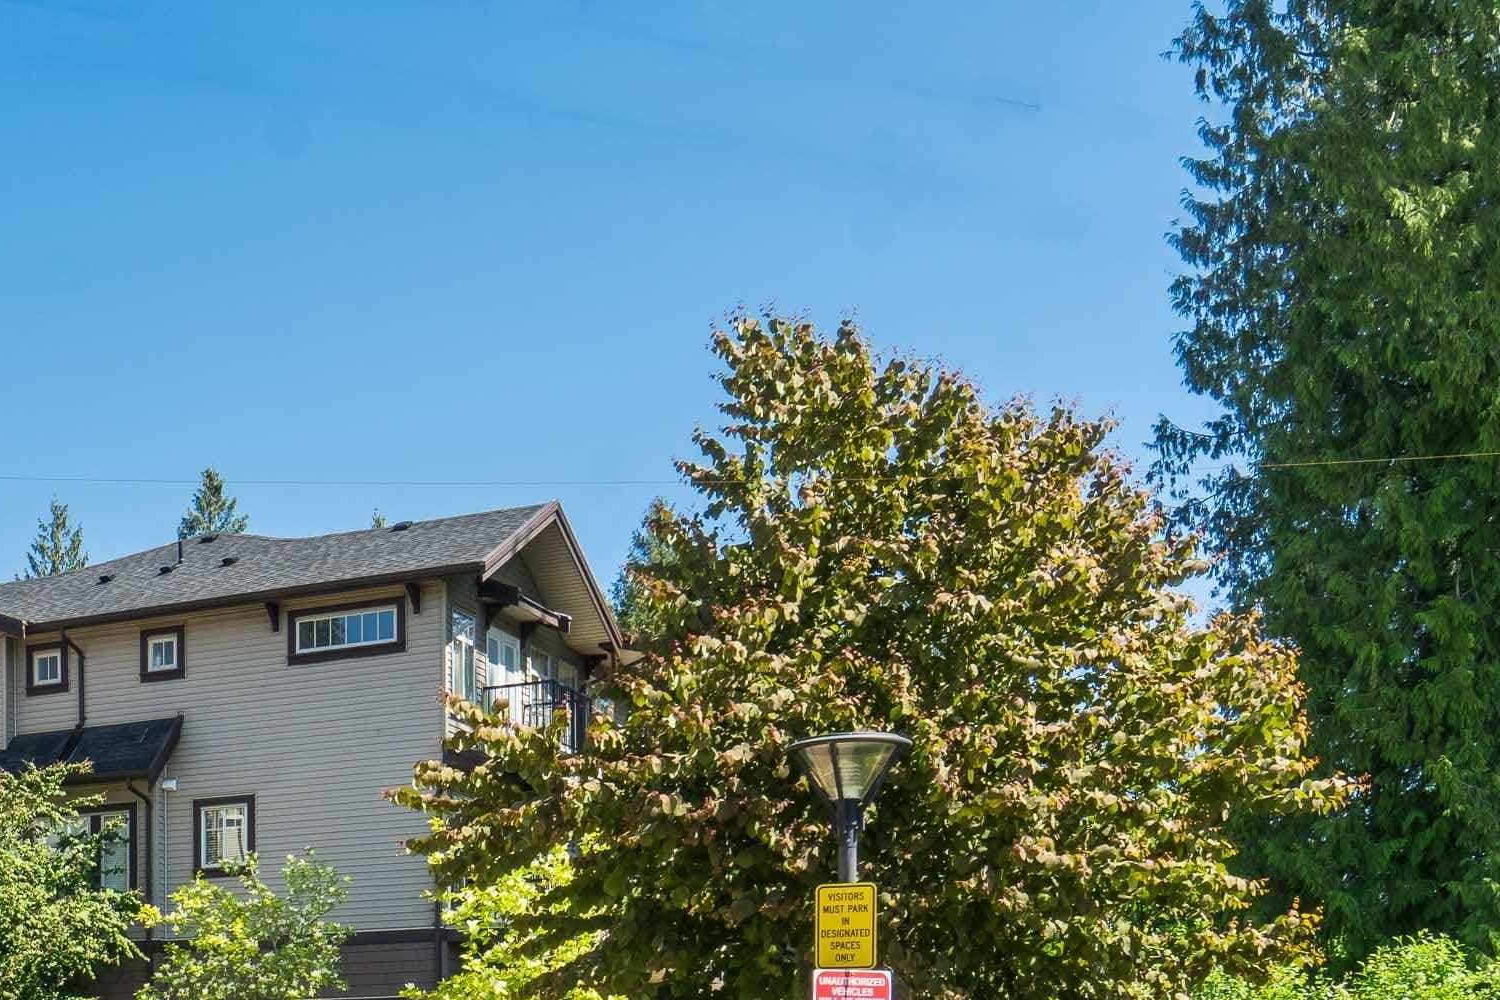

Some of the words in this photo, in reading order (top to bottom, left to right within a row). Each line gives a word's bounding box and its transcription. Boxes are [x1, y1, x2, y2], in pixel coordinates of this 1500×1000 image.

[828, 892, 864, 901] VISITORS
[823, 905, 844, 914] MUST
[848, 904, 868, 912] PARK
[841, 917, 850, 925] IN
[821, 929, 870, 938] DESIGNATED
[830, 941, 860, 950] SPACES
[835, 953, 855, 962] ONLY
[831, 987, 874, 996] VEHICLES
